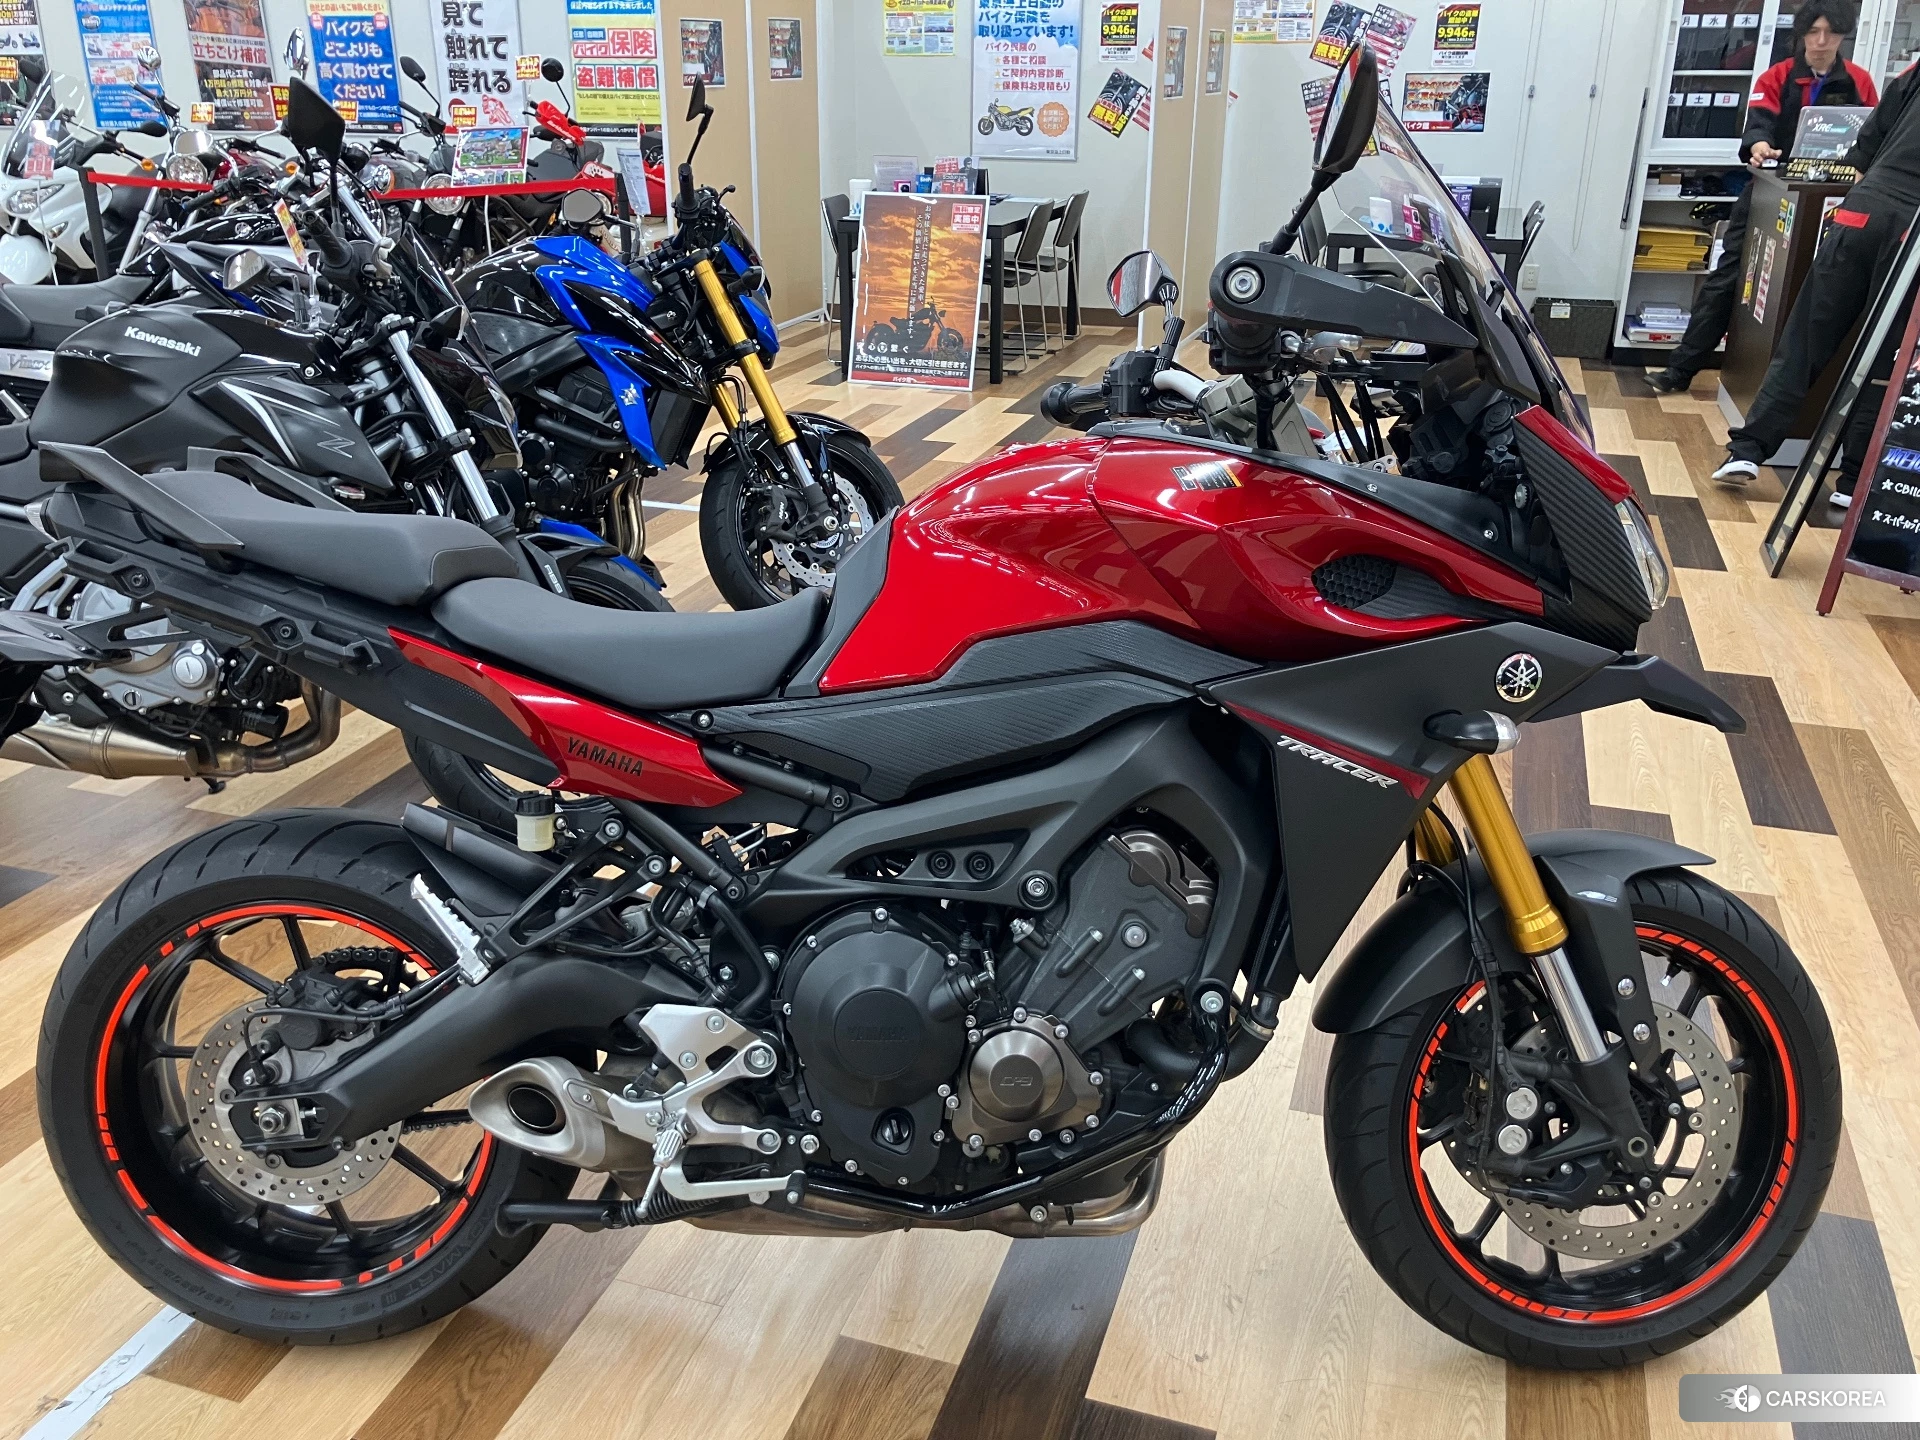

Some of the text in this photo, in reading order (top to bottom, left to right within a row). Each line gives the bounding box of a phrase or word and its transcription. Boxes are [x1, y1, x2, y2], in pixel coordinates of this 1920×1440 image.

[443, 1, 483, 27] 見て
[979, 10, 1050, 23] バイク保険を
[1682, 16, 1691, 25] 月
[1709, 15, 1719, 26] 水
[1741, 15, 1752, 26] 木
[326, 21, 375, 36] バイクを
[978, 25, 1074, 38] 取り扱っています!
[1102, 24, 1136, 35] 9,946件
[1437, 27, 1475, 38] 9,946件
[445, 34, 508, 60] 触れて
[610, 30, 654, 55] 保険
[985, 42, 1037, 52] バイク保険の
[193, 42, 267, 64] 立ちごけ補償
[325, 42, 382, 58] どこよりも
[574, 44, 609, 56] バイク
[1002, 55, 1047, 65] 各種ご相談
[319, 62, 393, 79] 高く買わせて
[577, 66, 656, 88] 盗難補償
[1002, 68, 1064, 78] ご契約内容診断
[448, 68, 512, 94] 跨れる
[1002, 81, 1071, 91] 保険料お見積もり
[334, 84, 386, 99] ください!
[1668, 94, 1676, 104] 金
[1694, 95, 1704, 104] 土
[1722, 95, 1731, 104] 日
[953, 215, 980, 224] 実施中
[124, 326, 201, 357] Kawasaki
[544, 564, 563, 594] ABS
[567, 736, 644, 777] YAMAHA
[1276, 735, 1399, 789] TRACER
